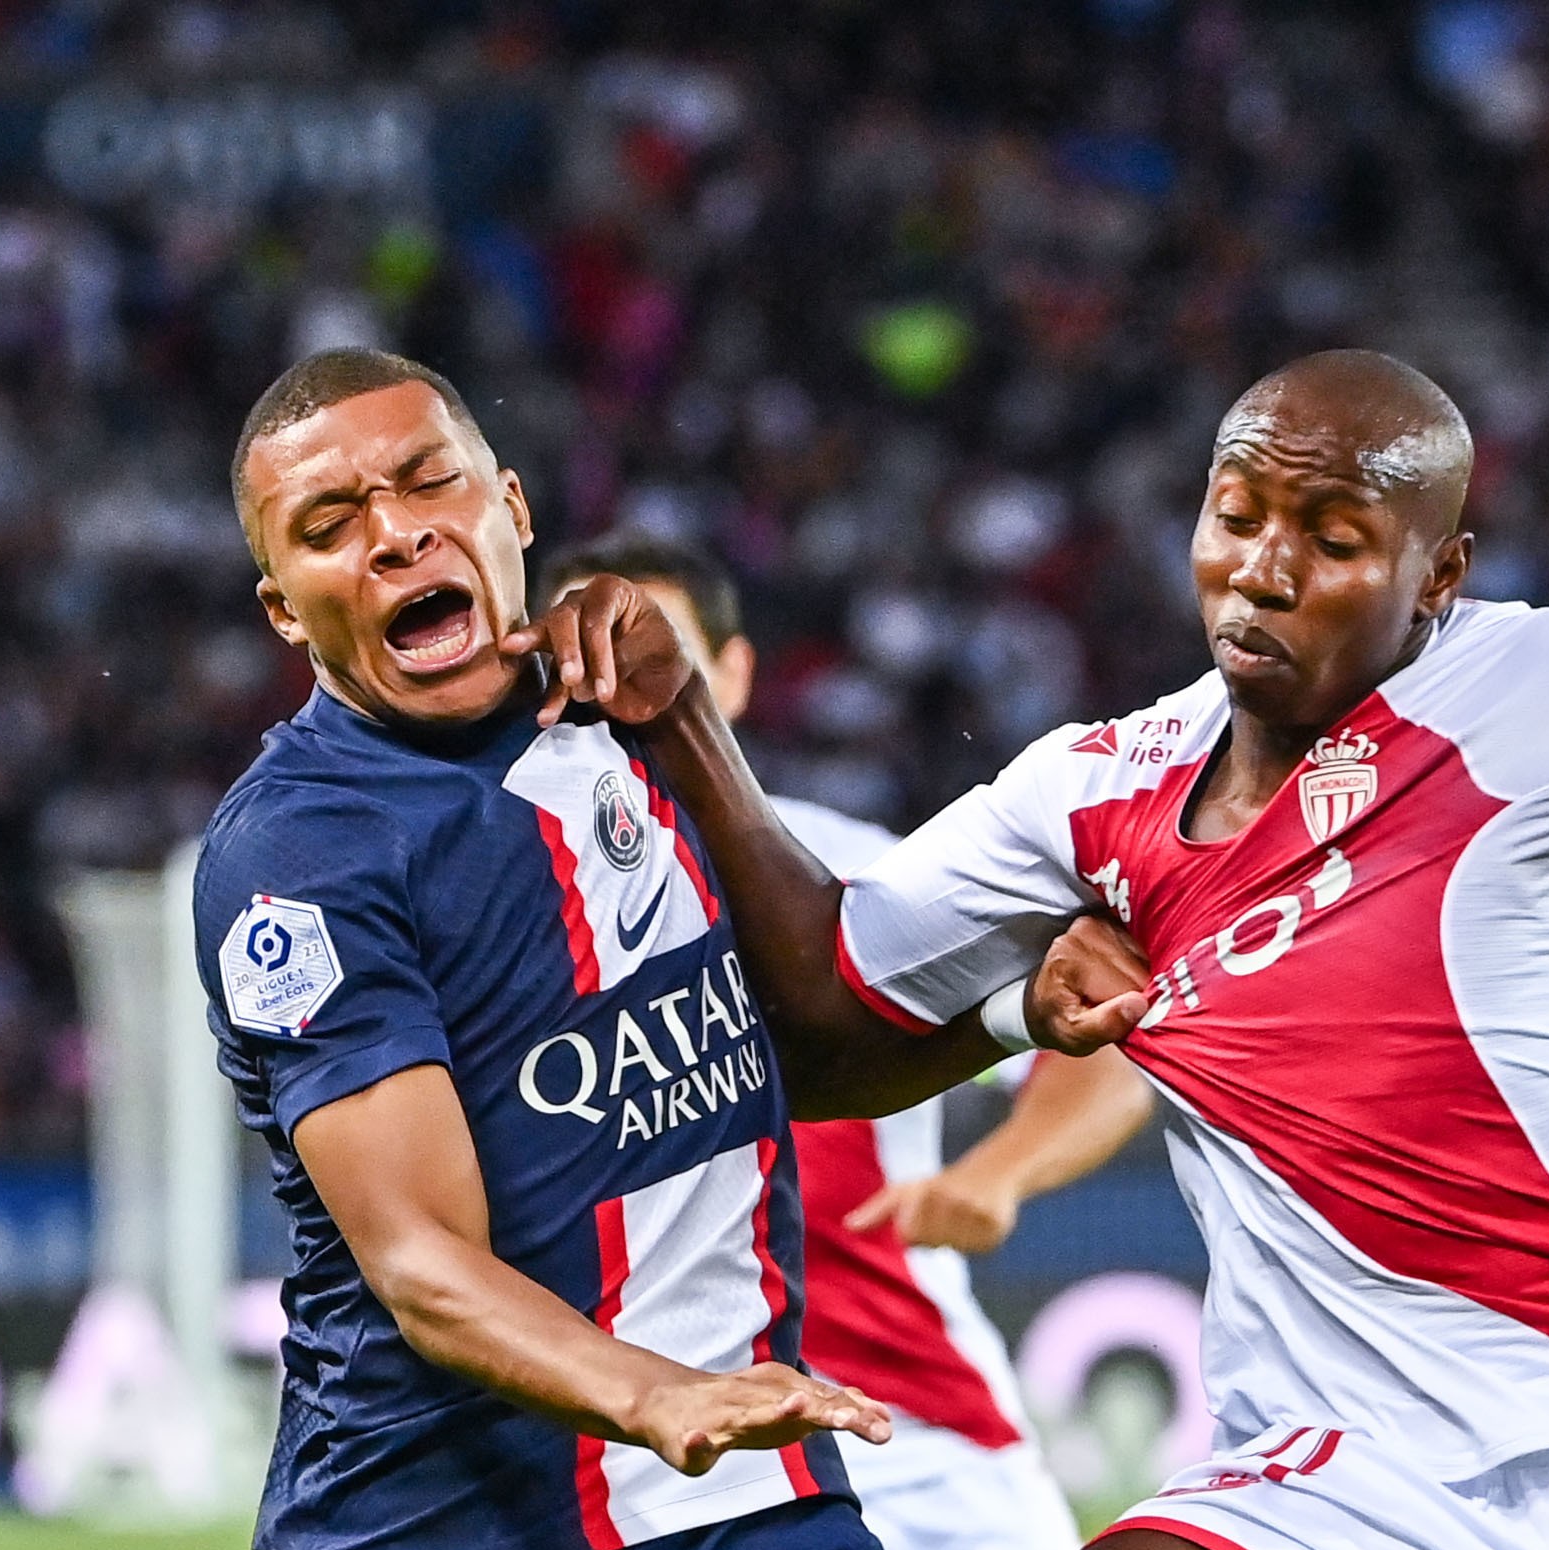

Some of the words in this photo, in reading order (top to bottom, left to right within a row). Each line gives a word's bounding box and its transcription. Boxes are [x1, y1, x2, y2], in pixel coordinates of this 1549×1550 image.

[255, 994, 284, 1012] Uber
[285, 981, 315, 999] Eats
[257, 972, 296, 995] LIGUE
[518, 950, 758, 1124] QATAR
